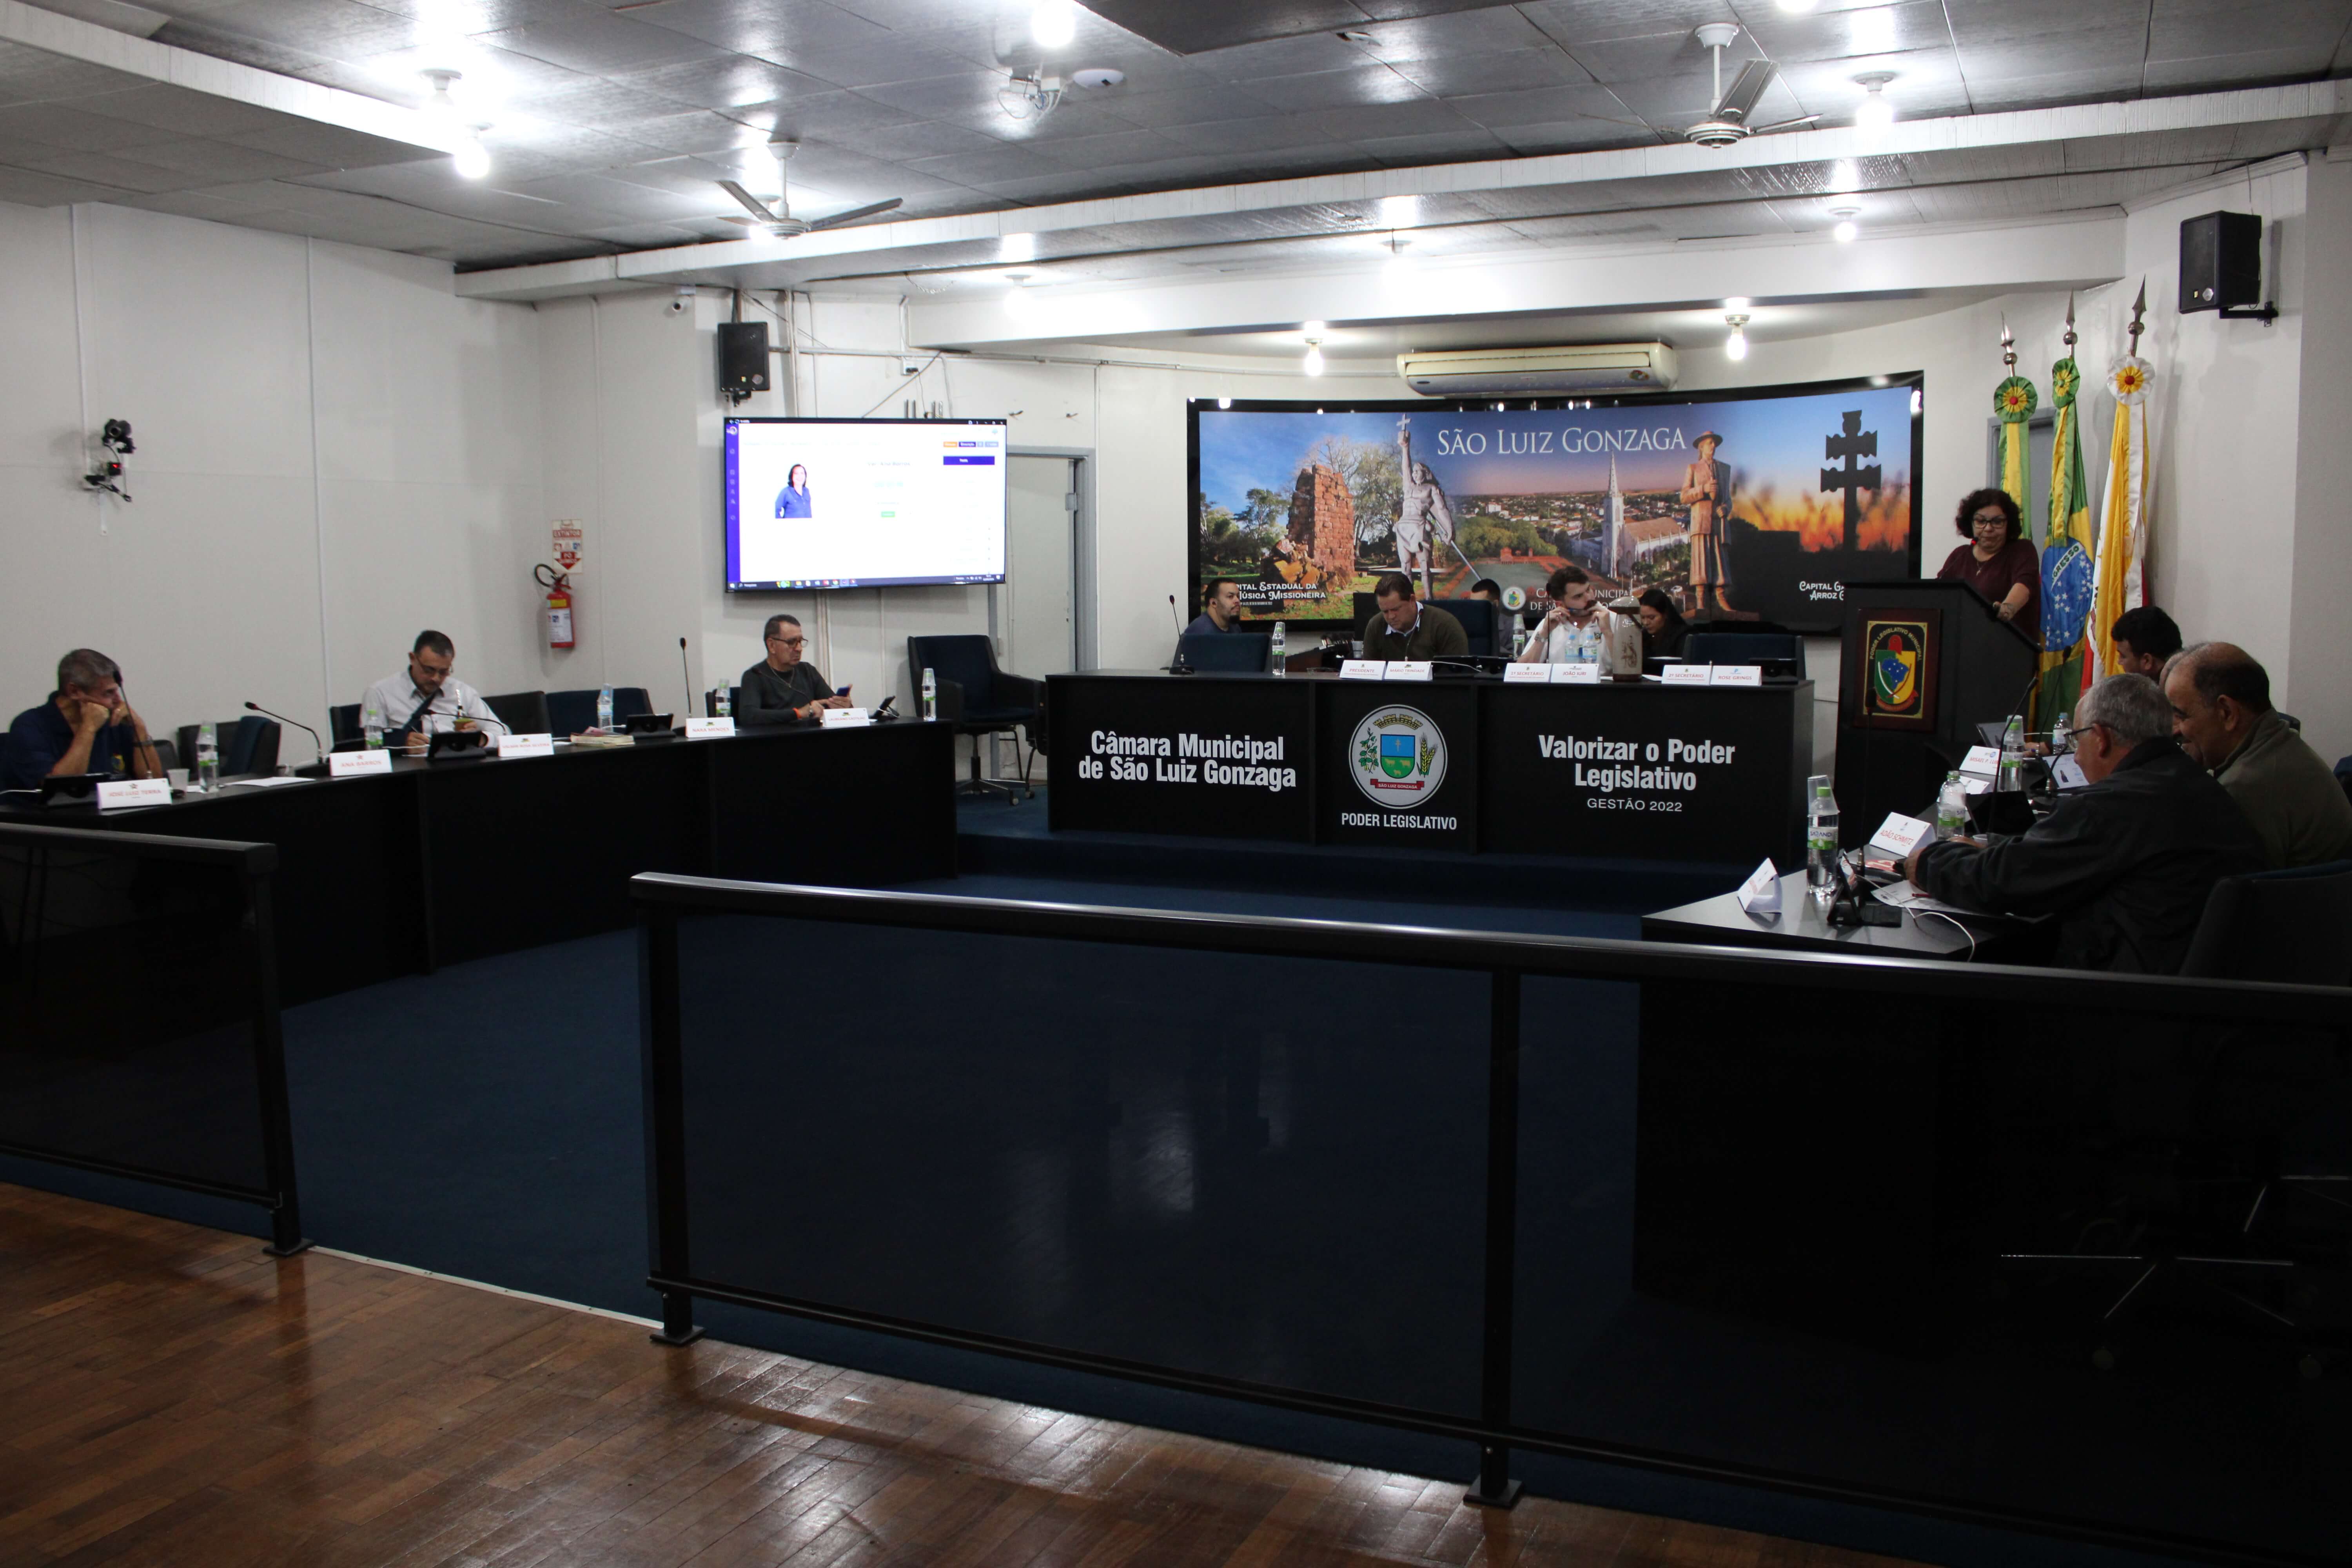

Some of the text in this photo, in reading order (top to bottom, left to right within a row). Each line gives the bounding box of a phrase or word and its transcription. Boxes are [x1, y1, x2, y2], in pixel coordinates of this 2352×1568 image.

[1437, 427, 1687, 455] SÃO LUIZ GONZAGA
[1268, 591, 1326, 601] MISSIONEIRA
[1809, 590, 1837, 601] ARROZ
[1091, 731, 1283, 764] Câmara Municipal
[1539, 735, 1735, 764] Valorizar o Poder
[1079, 756, 1296, 792] de São Luiz Gonzaga
[1575, 763, 1696, 792] Legislativo
[1587, 797, 1682, 812] GESTÃO 2022
[1341, 812, 1457, 830] PODER LEGISLATIVO
